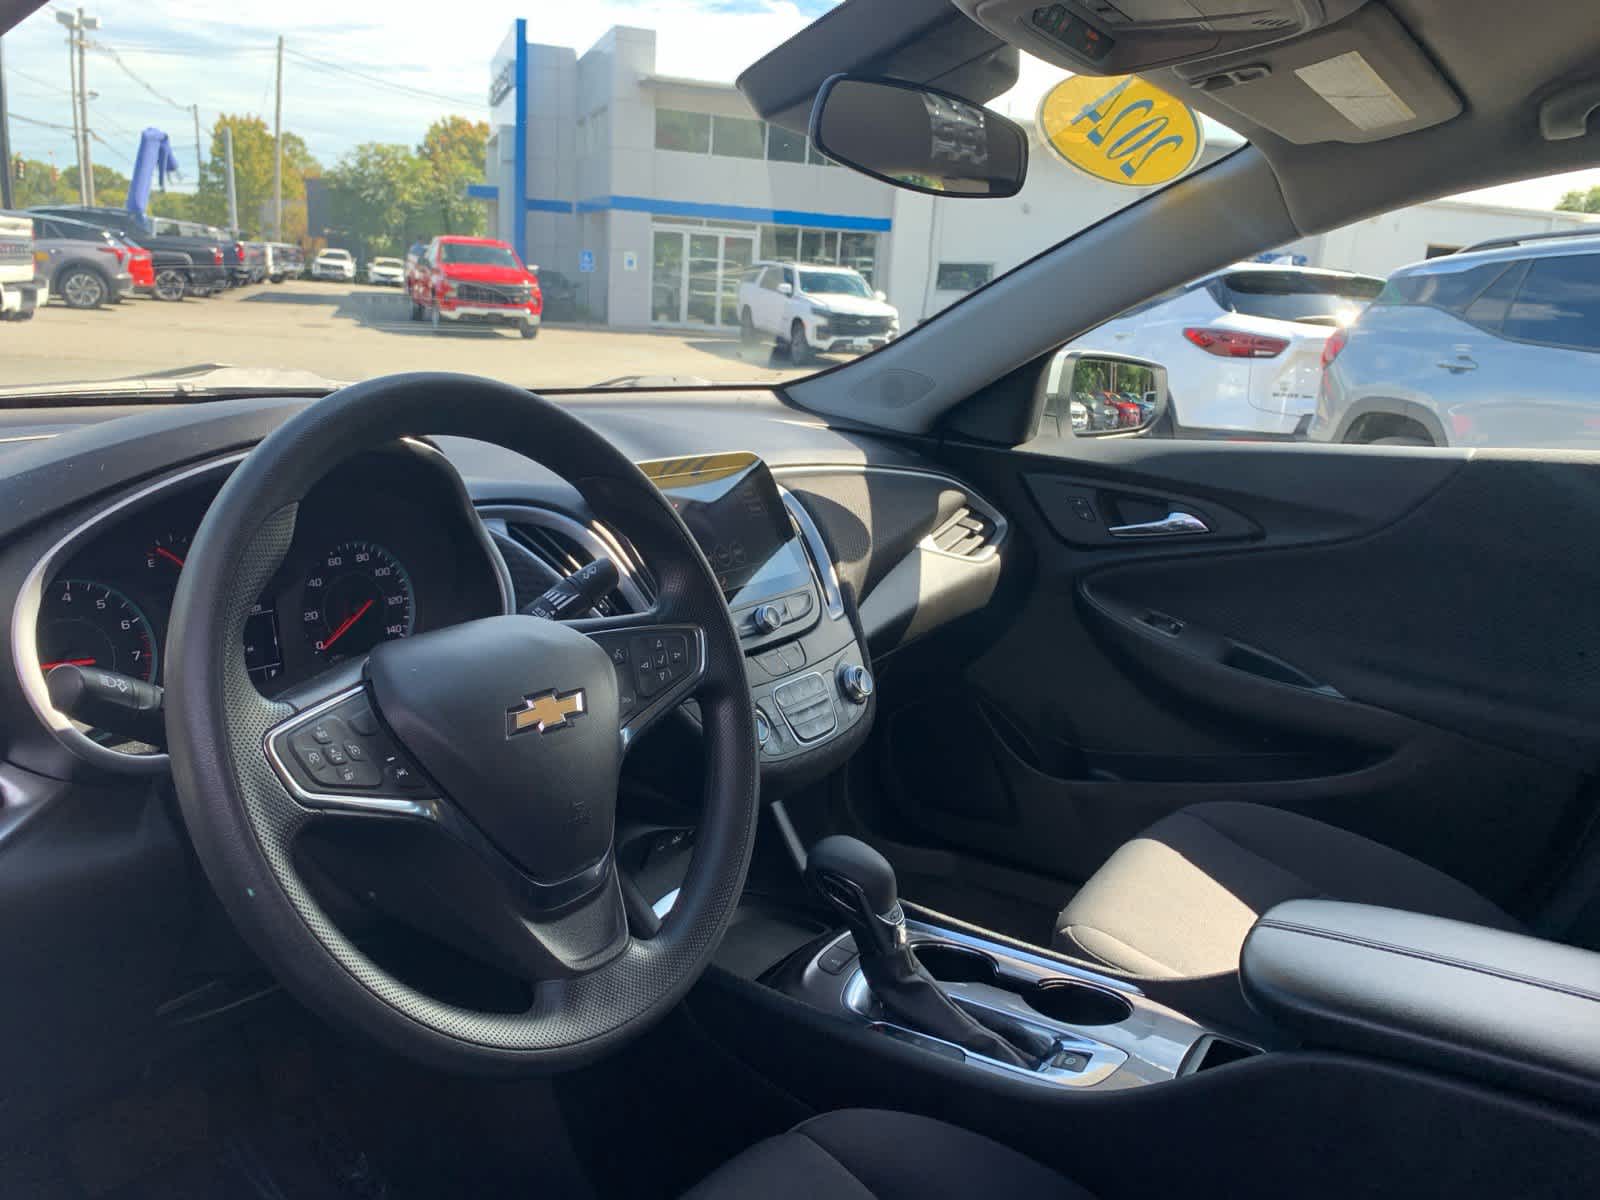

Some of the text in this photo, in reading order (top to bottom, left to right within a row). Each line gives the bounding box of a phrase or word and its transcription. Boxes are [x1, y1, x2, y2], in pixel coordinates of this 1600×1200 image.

[327, 556, 343, 567] 60
[355, 552, 371, 563] 80
[147, 559, 156, 568] E
[374, 566, 391, 577] 100
[308, 577, 323, 588] 40
[62, 592, 72, 603] 4
[387, 595, 404, 606] 120
[95, 599, 106, 609] 5
[303, 610, 319, 622] 20
[120, 619, 131, 630] 6
[386, 624, 403, 635] 140
[315, 640, 324, 650] 0
[131, 650, 141, 661] 7
